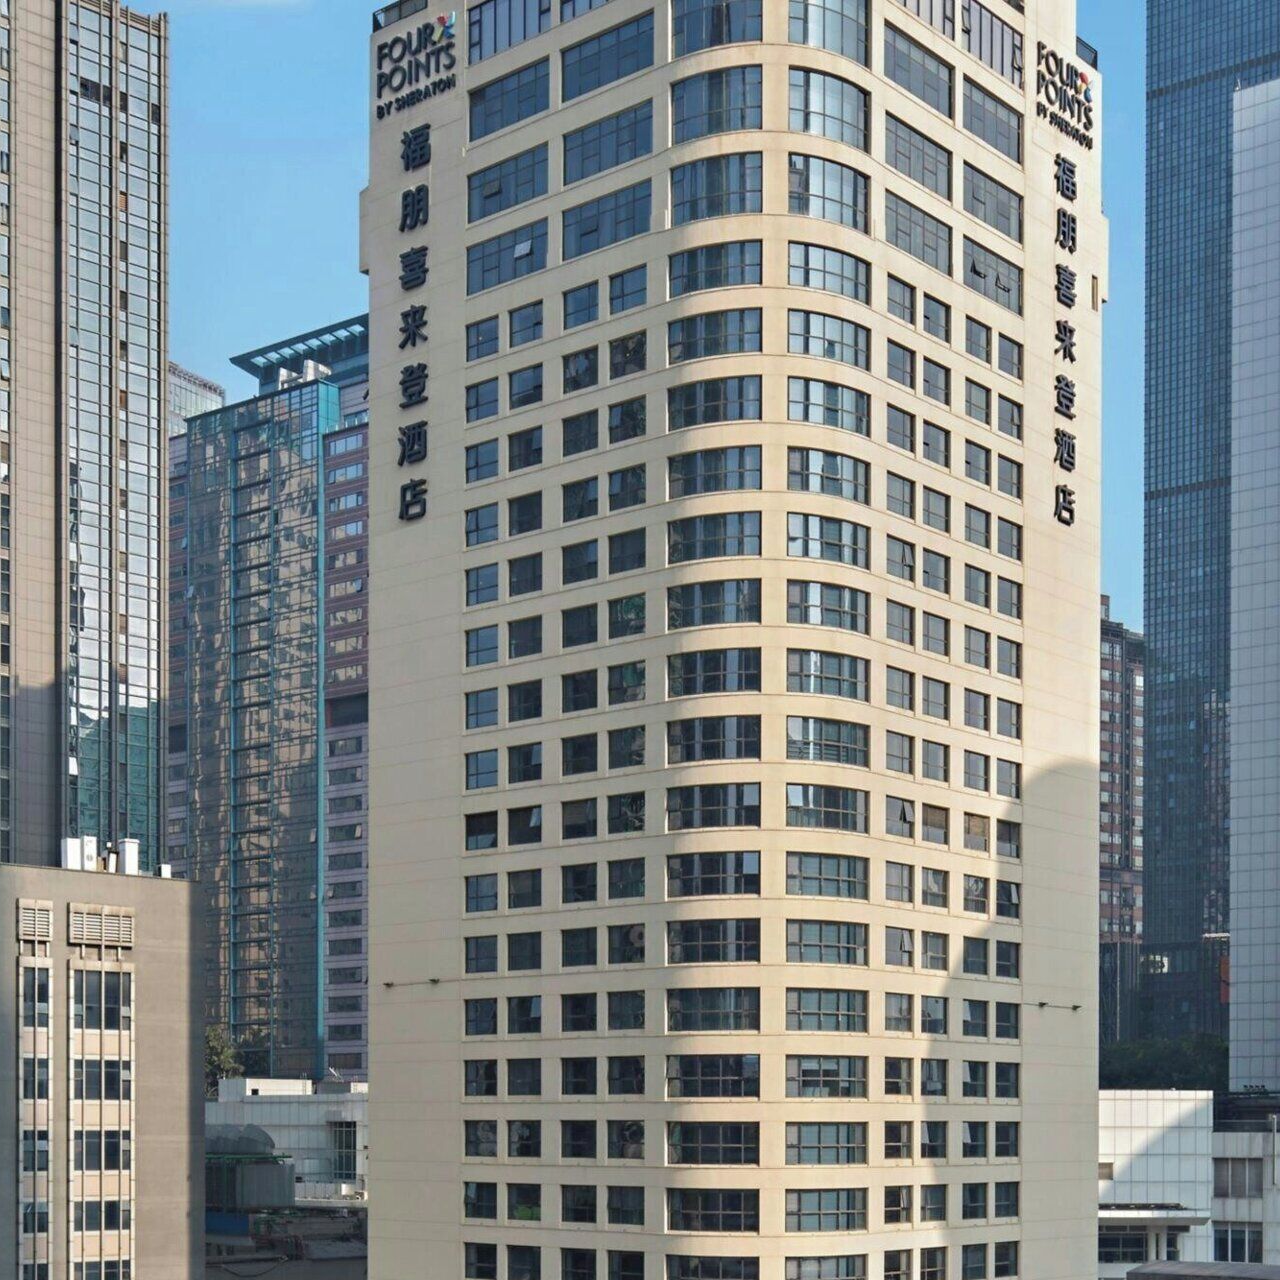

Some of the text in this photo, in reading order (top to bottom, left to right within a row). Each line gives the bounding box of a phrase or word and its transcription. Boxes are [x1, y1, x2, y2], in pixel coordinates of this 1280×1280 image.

[377, 22, 437, 70] FOUR
[377, 41, 457, 99] POINTS
[1037, 41, 1080, 95] FOUR
[376, 73, 457, 120] BY SHERATON
[1037, 70, 1093, 132] POINTS
[398, 123, 432, 521] 福朋喜来登酒店
[1053, 153, 1078, 527] 福朋喜来登酒店
